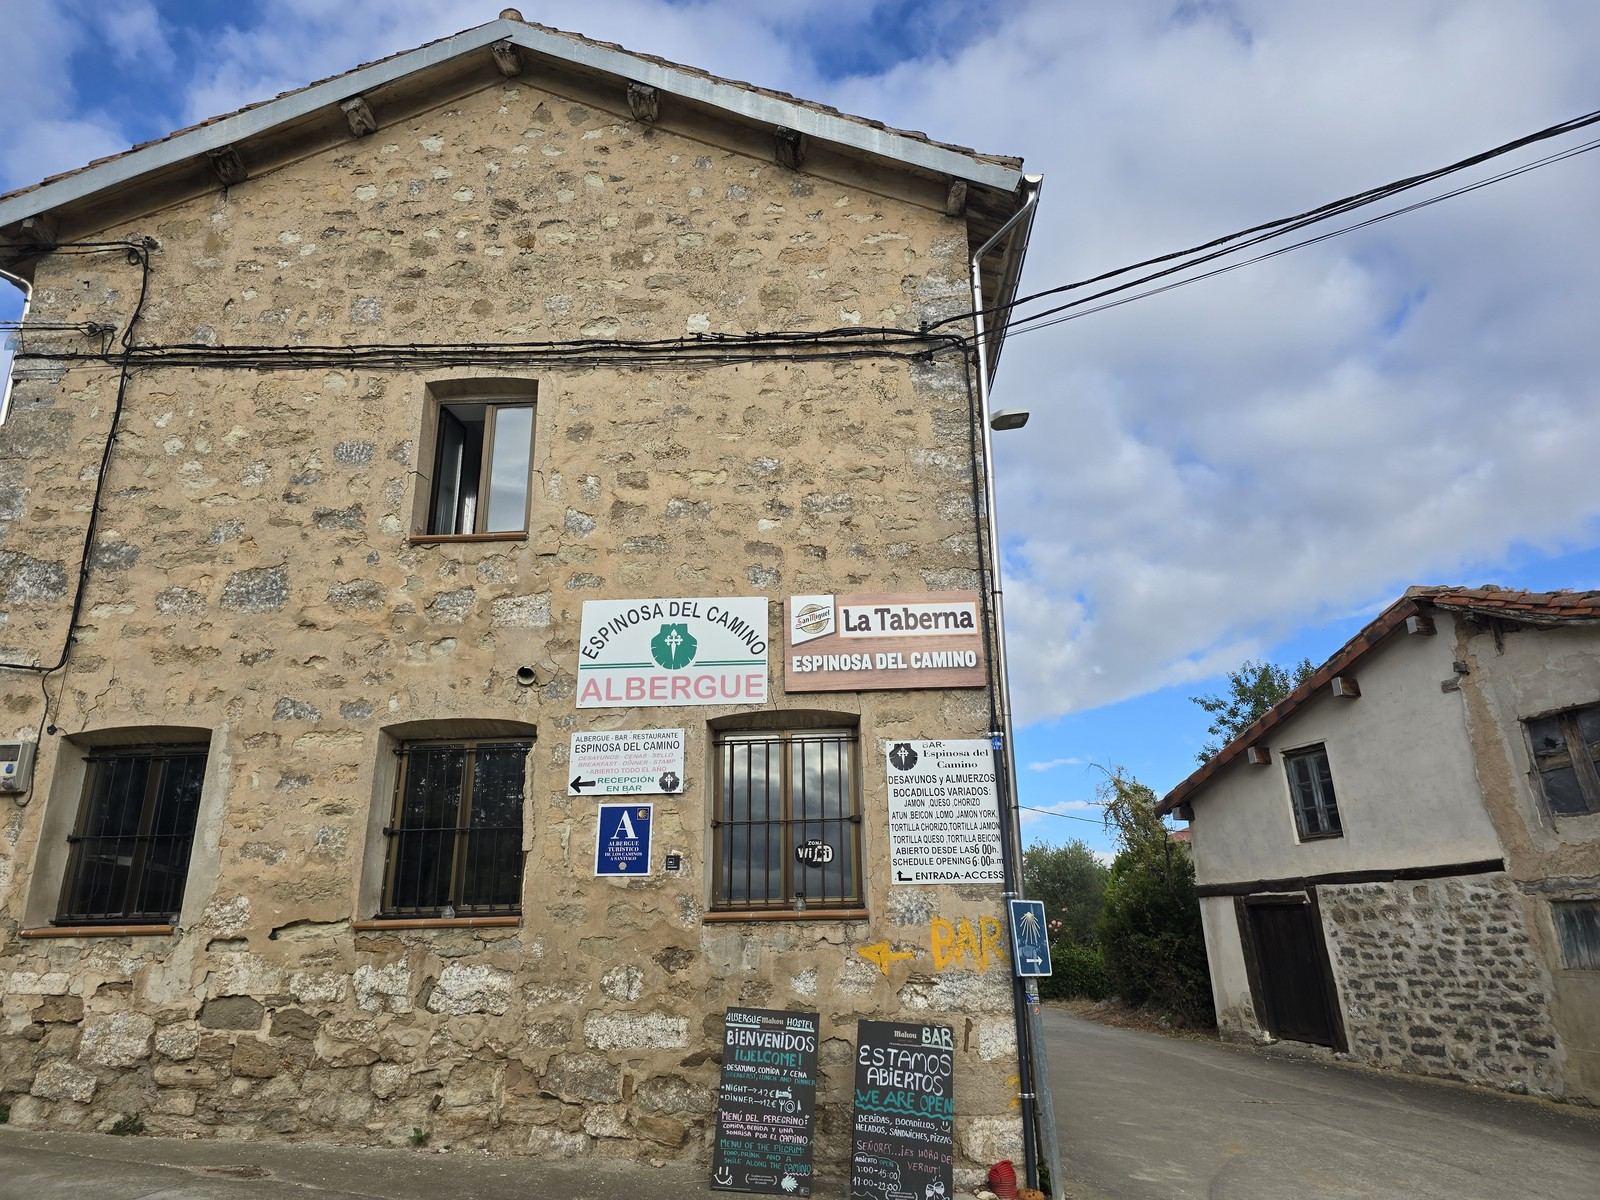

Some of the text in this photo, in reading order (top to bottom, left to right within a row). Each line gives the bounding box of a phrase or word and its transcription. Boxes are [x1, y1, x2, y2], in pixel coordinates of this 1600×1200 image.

[843, 607, 974, 632] La Taberna
[582, 601, 766, 660] ESPINOSA DEL CAMINO
[792, 650, 977, 672] ESPINOSA DEL CAMINO
[580, 673, 764, 703] ALBERGUE
[632, 732, 678, 740] RESTAURANTE
[575, 740, 680, 754] ESPINOSA DEL CAMINO
[923, 749, 989, 759] Espinosa del
[936, 760, 978, 769] Camino
[597, 775, 655, 784] RECEPCIÓN
[888, 774, 937, 785] DESAYUNOS
[945, 773, 996, 784] ALMUERZOS
[893, 787, 945, 797] BOCADILLOS
[610, 810, 639, 840] A
[891, 823, 920, 832] TORTILLA
[893, 835, 921, 844] TORTILLA
[923, 834, 945, 844] QUESO
[896, 846, 930, 855] ABIERTO
[931, 846, 958, 854] DESDE
[892, 857, 934, 866] SCHEDULE
[936, 857, 971, 865] OPENING
[930, 915, 1007, 975] BAR
[725, 1012, 761, 1024] ALBERGUE
[786, 1017, 814, 1030] HOSTEL
[893, 1030, 917, 1039] Mahou
[922, 1026, 953, 1050] BAR
[859, 1044, 952, 1077] ESTAMOS
[789, 1070, 808, 1079] CENA
[856, 1088, 953, 1113] WE ARE OPEN
[745, 1113, 759, 1122] DEL
[720, 1139, 742, 1149] MENU
[745, 1141, 754, 1150] OF
[757, 1142, 770, 1152] THE
